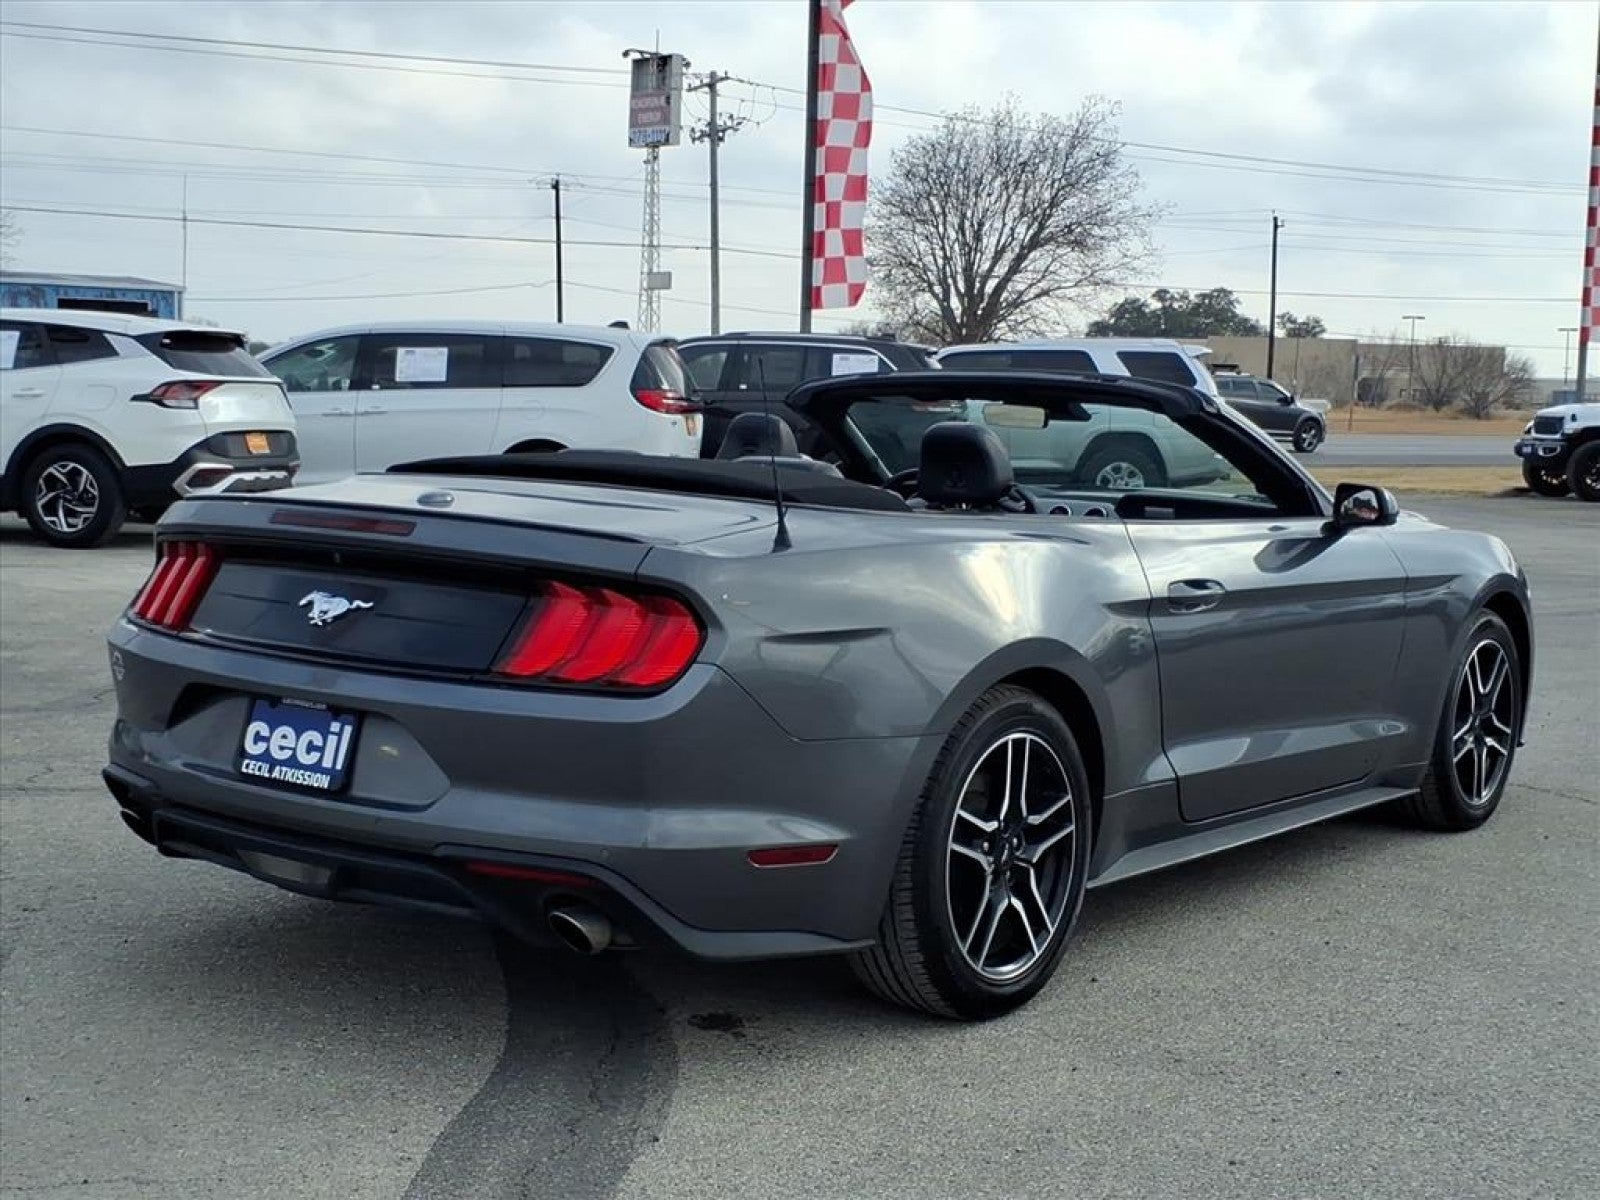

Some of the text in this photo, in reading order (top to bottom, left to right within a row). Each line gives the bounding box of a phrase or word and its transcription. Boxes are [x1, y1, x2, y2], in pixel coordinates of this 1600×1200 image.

[244, 721, 353, 770] cecil
[241, 759, 331, 789] CECIL ATKISSION
